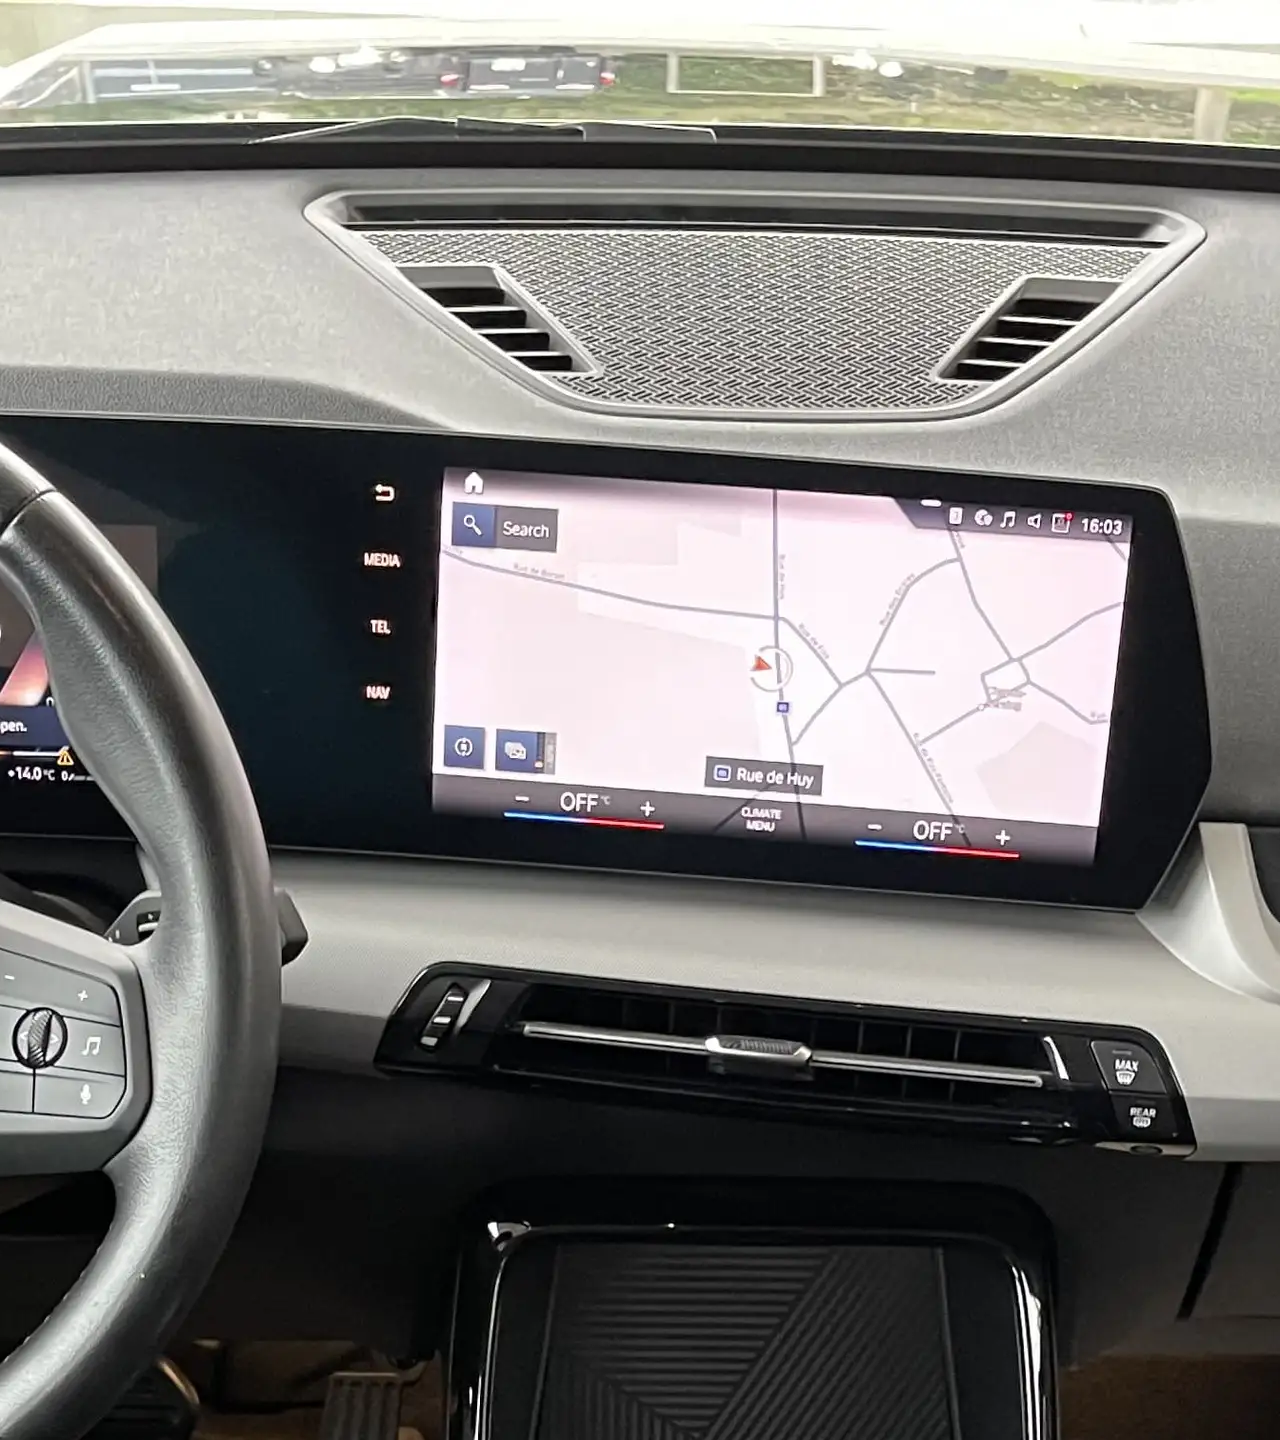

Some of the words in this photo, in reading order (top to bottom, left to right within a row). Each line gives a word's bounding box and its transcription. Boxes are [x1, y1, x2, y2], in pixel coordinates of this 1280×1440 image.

[502, 520, 549, 539] Search
[1081, 518, 1123, 535] 16:03
[364, 552, 401, 568] MEDIA
[370, 619, 391, 634] TEL
[366, 685, 390, 700] NAV
[8, 766, 42, 781] +14.0
[737, 767, 763, 783] Rue
[766, 770, 784, 785] de
[787, 772, 814, 789] Huy
[560, 791, 599, 812] OFF
[741, 807, 782, 819] CLIMATE
[746, 820, 776, 832] MENU
[913, 820, 954, 841] OFF
[1114, 1059, 1140, 1072] MAX
[1129, 1106, 1157, 1118] REAR
